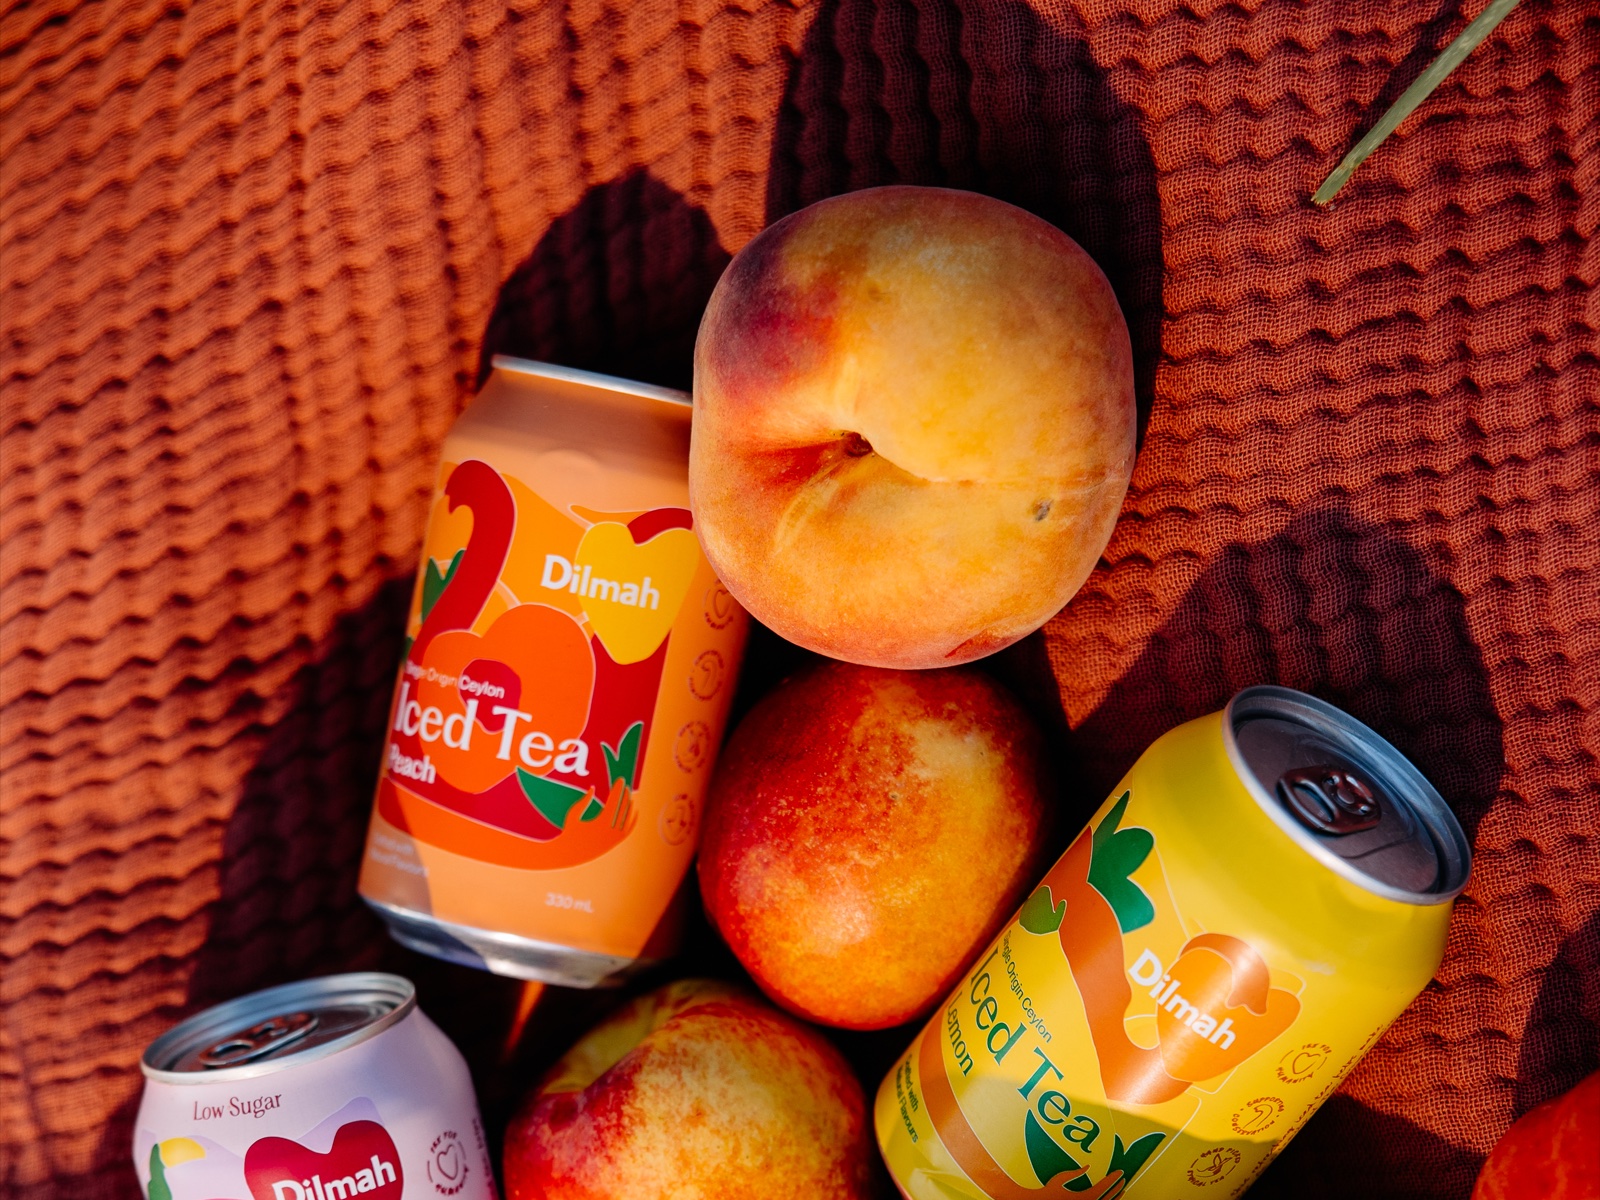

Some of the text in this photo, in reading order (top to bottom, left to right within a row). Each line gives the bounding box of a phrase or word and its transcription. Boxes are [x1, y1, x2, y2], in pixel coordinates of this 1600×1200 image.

[540, 554, 660, 611] Dilmah
[393, 680, 480, 752] Iced
[491, 704, 591, 777] Tea
[457, 674, 506, 700] Ceylon
[947, 990, 975, 1078] Lemon
[1006, 961, 1025, 1000] Origin
[1021, 996, 1053, 1044] Ceylon
[1128, 948, 1237, 1051] Dilmah
[970, 945, 1102, 1154] Iced Tea
[193, 1093, 282, 1121] Low Sugar
